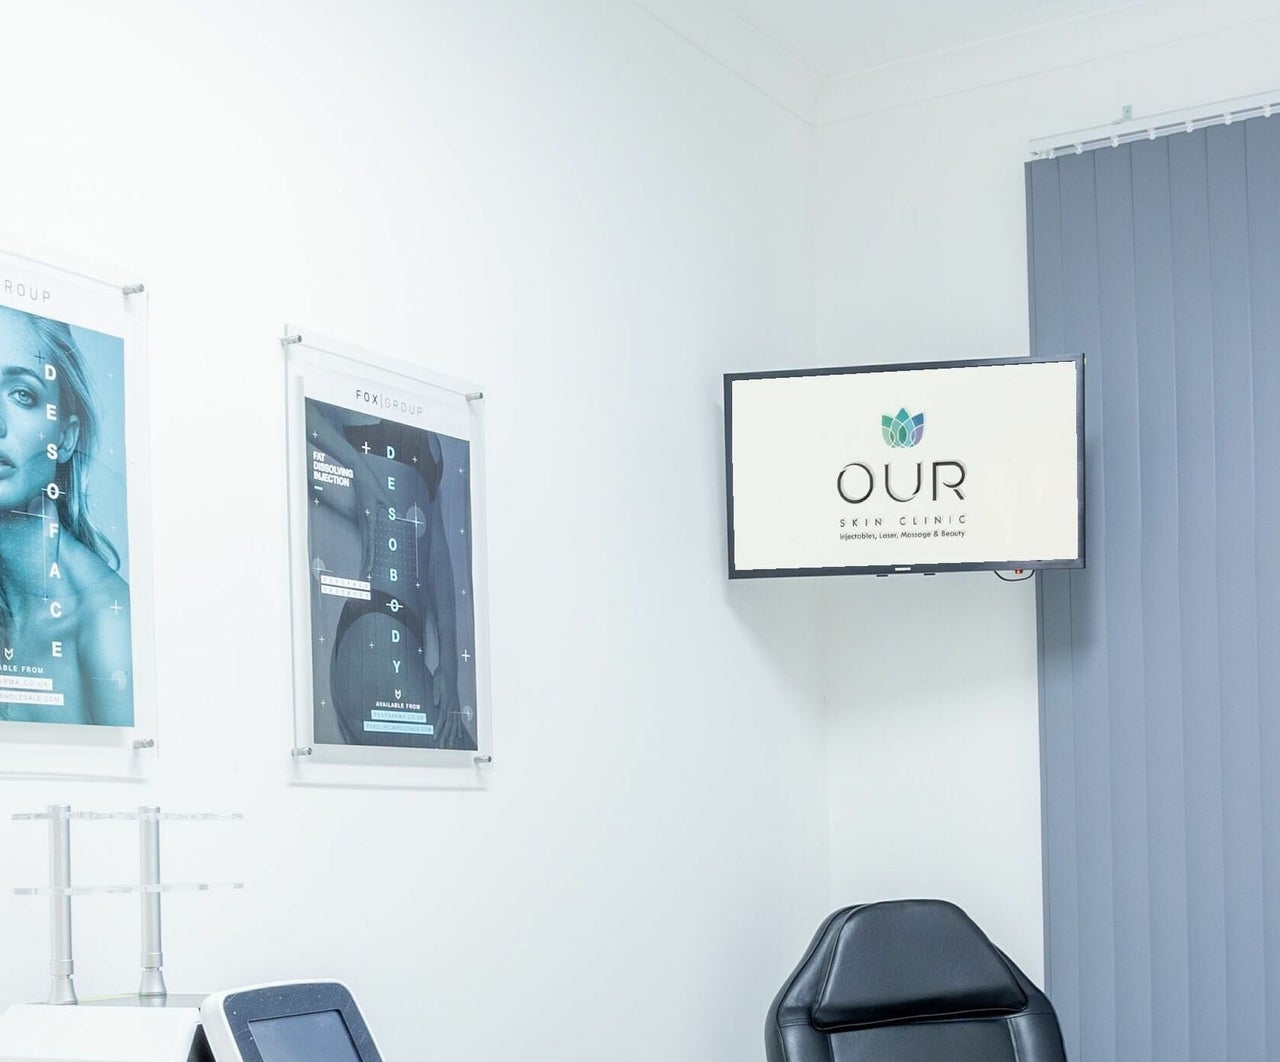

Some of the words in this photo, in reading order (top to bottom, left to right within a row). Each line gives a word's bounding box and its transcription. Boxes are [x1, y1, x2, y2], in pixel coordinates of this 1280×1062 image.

[313, 451, 326, 461] FAT
[313, 460, 353, 478] DISSOLVING
[313, 470, 350, 487] INJECTION
[837, 460, 967, 504] OUR
[840, 517, 882, 527] SKIN
[899, 515, 966, 526] CLINIC
[840, 532, 877, 541] Injectables,
[880, 532, 899, 540] Laser,
[901, 531, 931, 540] Massage
[941, 529, 965, 538] Beauty
[21, 665, 44, 674] FROM
[376, 701, 405, 709] AVAILABLE
